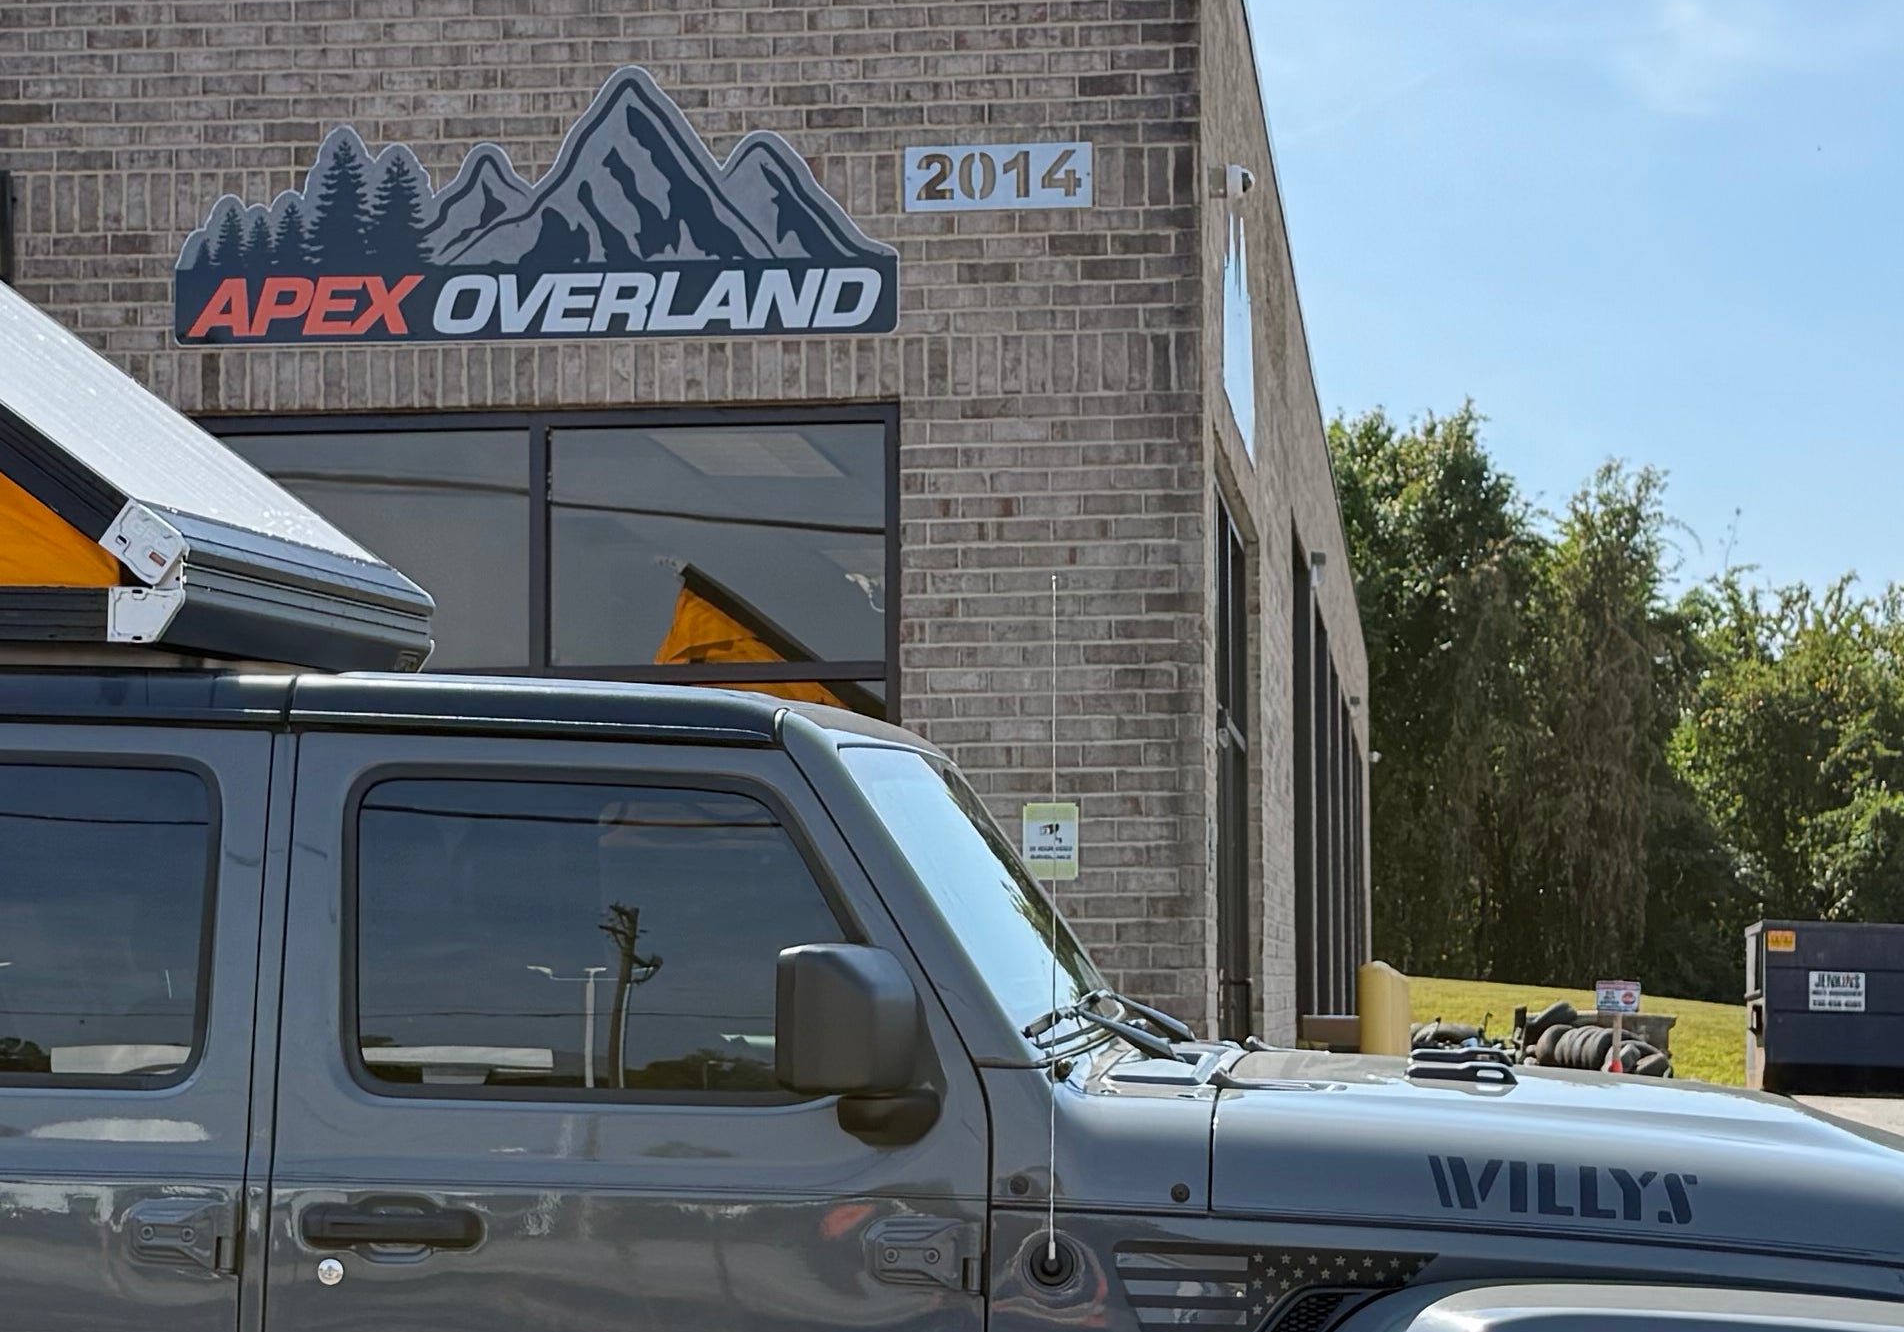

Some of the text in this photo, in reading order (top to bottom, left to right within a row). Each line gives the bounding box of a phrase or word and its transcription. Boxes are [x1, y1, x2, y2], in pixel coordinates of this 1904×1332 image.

[916, 147, 1081, 202] 2014
[188, 267, 882, 337] APEX OVERLAND
[1429, 1155, 1698, 1225] WILLYS
